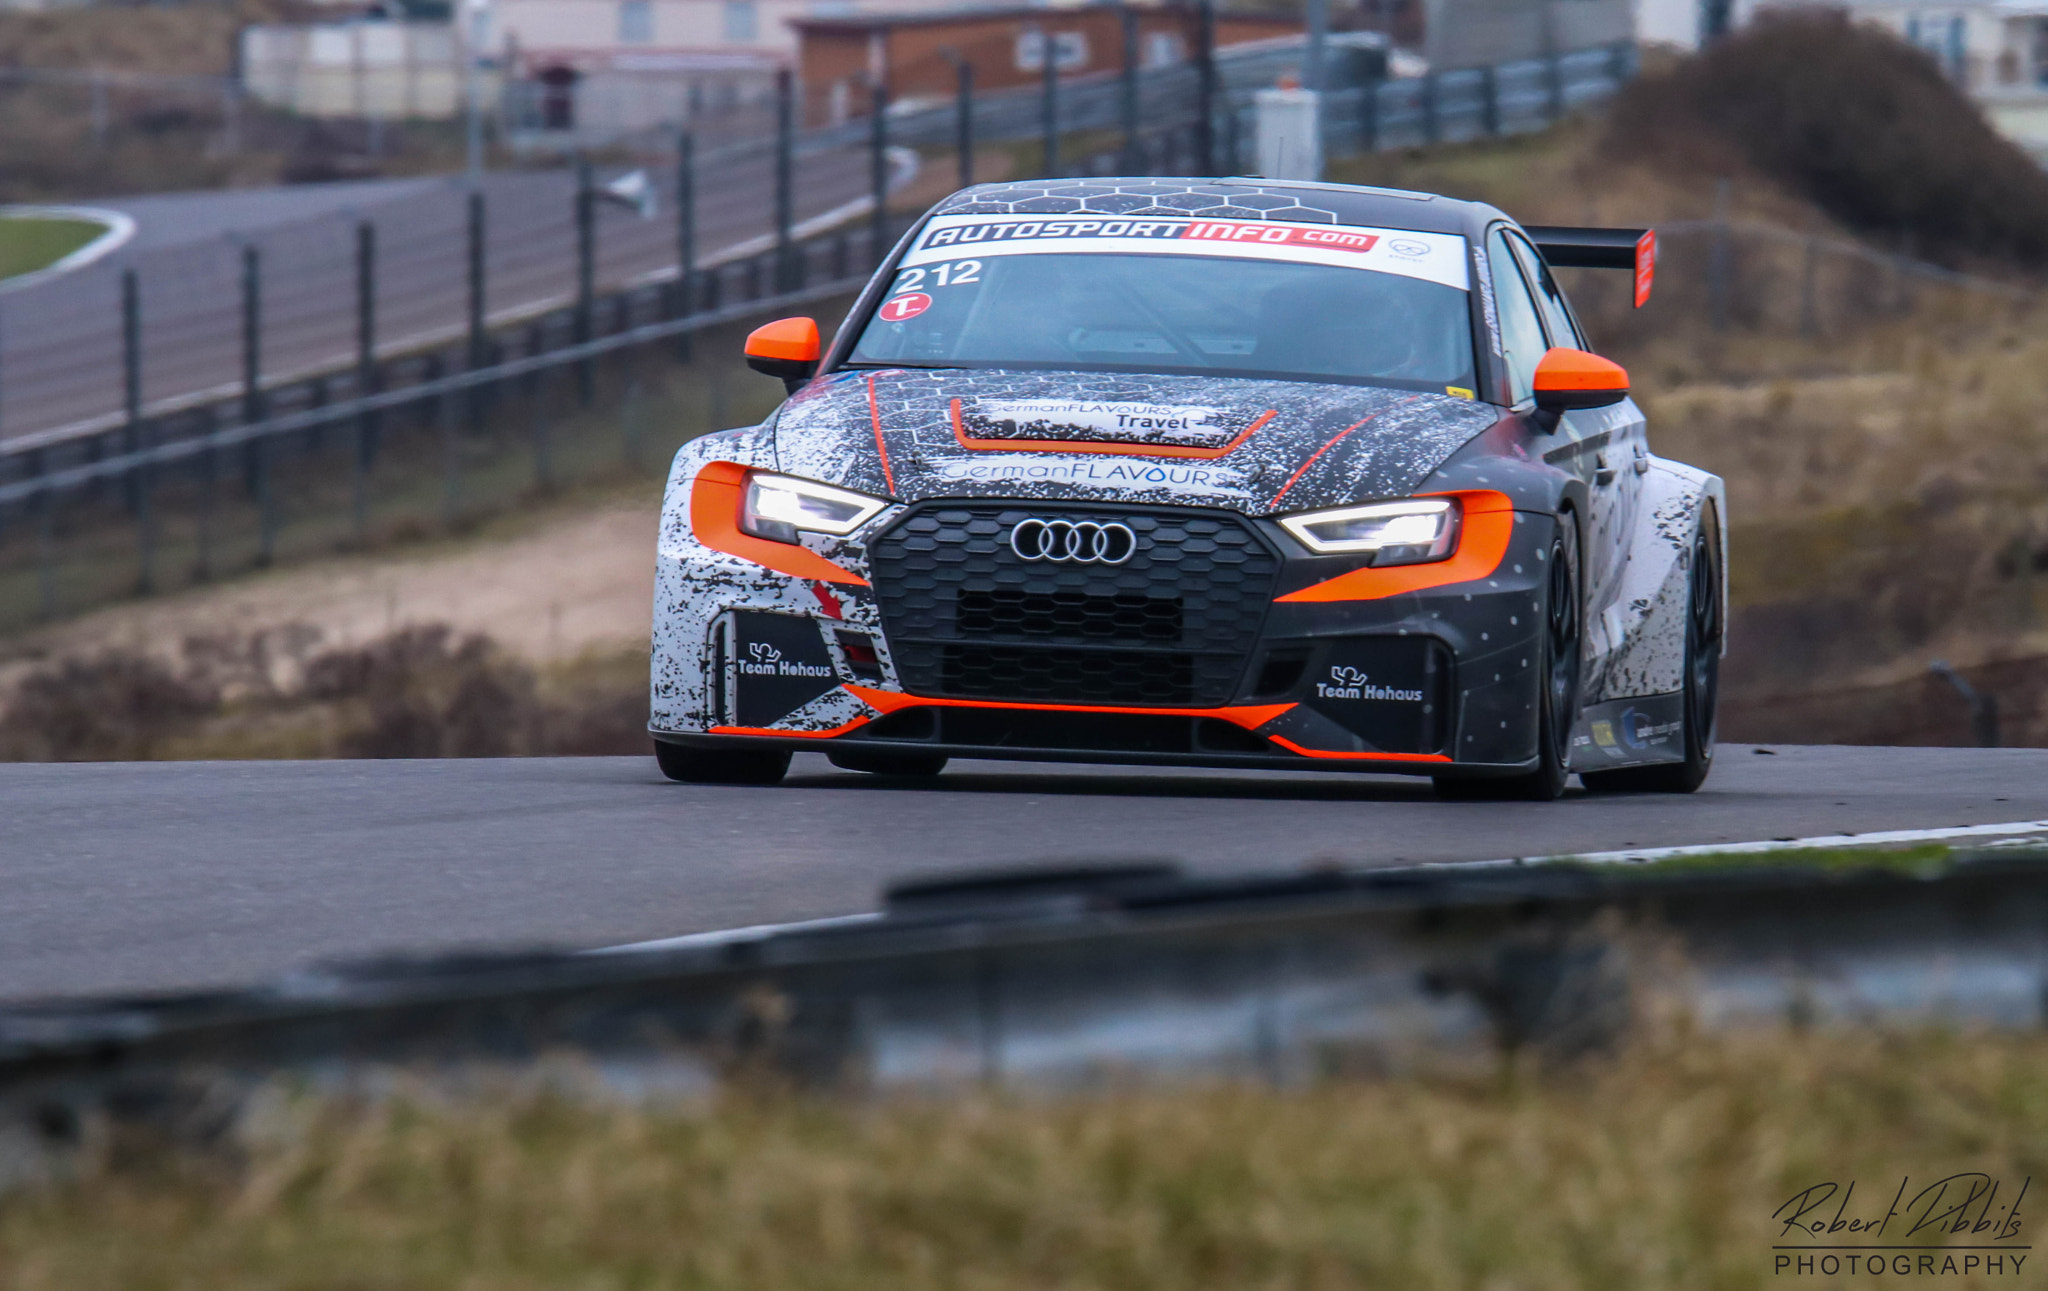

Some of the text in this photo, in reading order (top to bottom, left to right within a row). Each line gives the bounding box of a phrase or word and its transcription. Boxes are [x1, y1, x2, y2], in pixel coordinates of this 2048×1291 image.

[895, 260, 982, 294] 212
[1116, 414, 1188, 429] Travel
[738, 659, 775, 675] Team
[1317, 683, 1360, 699] Team
